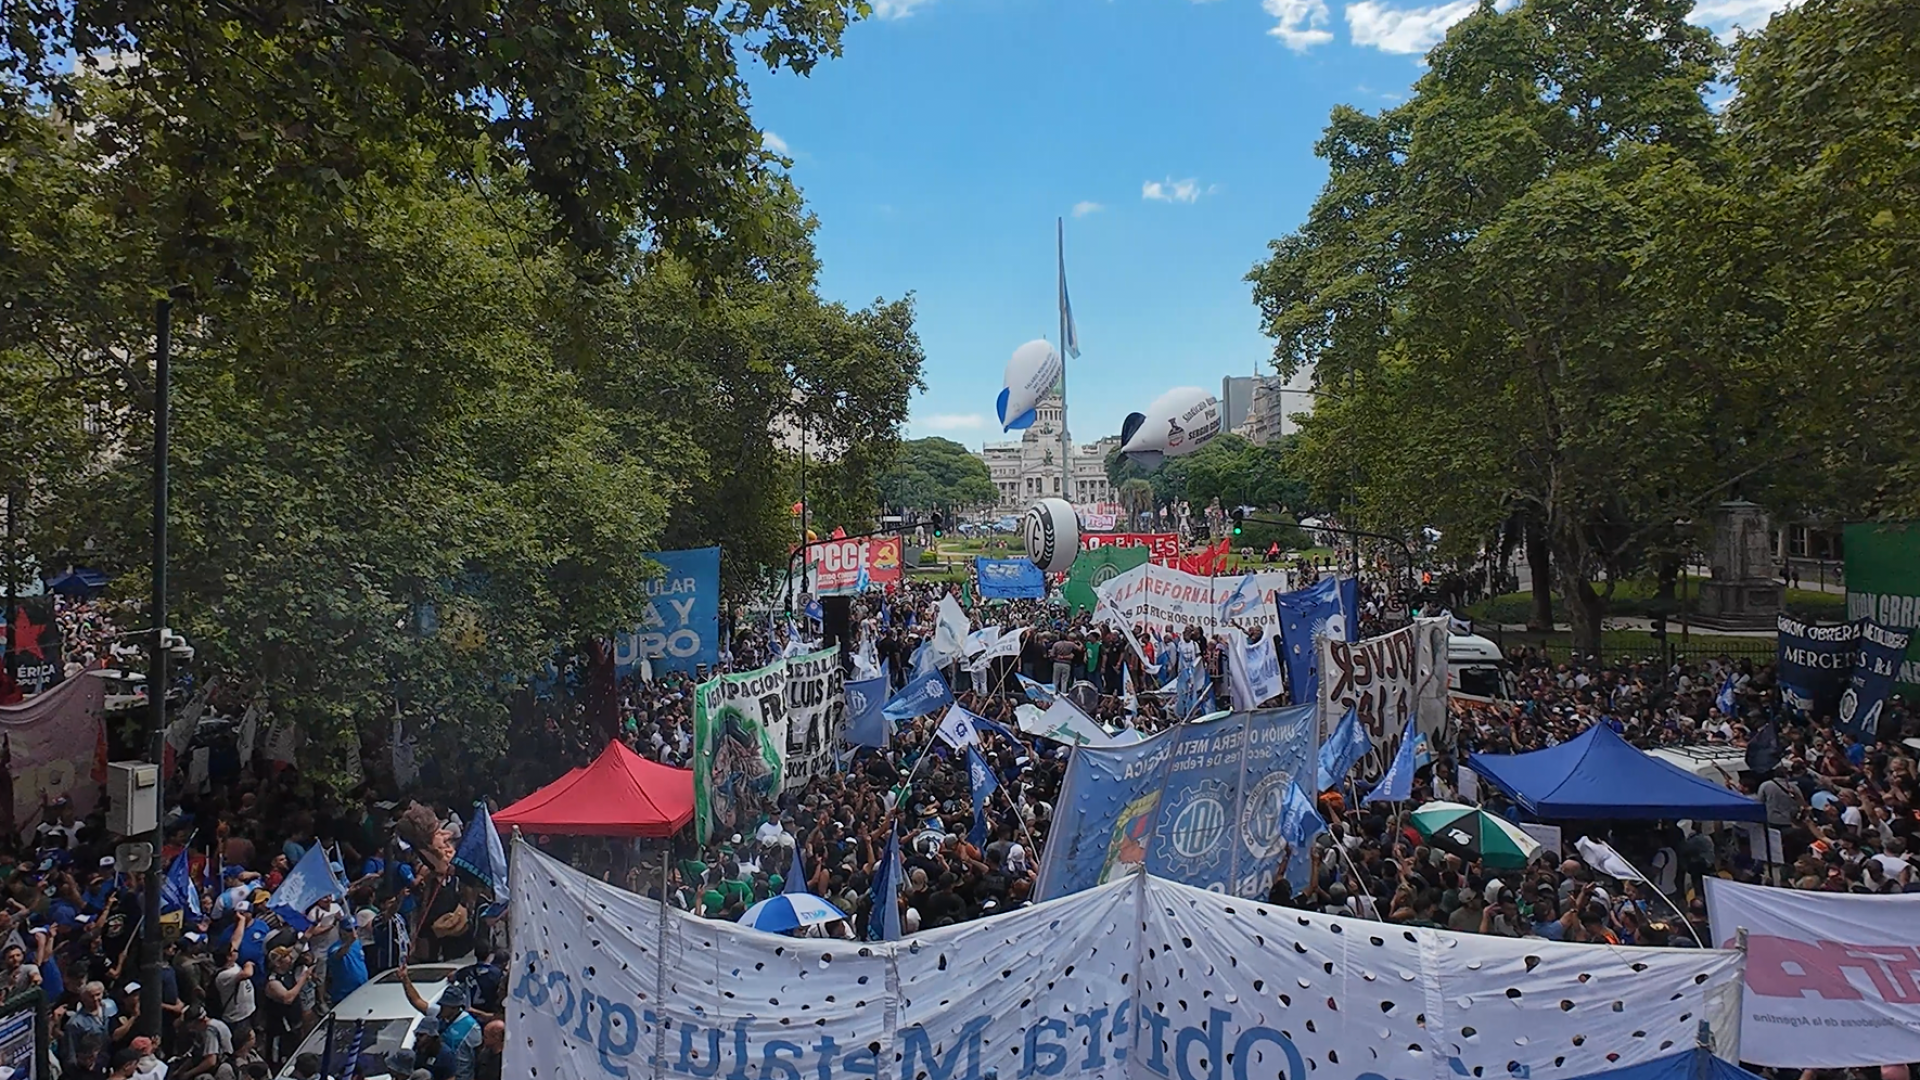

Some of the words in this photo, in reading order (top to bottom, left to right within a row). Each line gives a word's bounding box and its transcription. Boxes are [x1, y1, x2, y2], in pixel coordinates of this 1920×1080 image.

[1145, 576, 1209, 605] REFORMA
[1808, 623, 1861, 641] OBRERA
[614, 628, 701, 665] URO
[17, 663, 56, 678] ÉRICA
